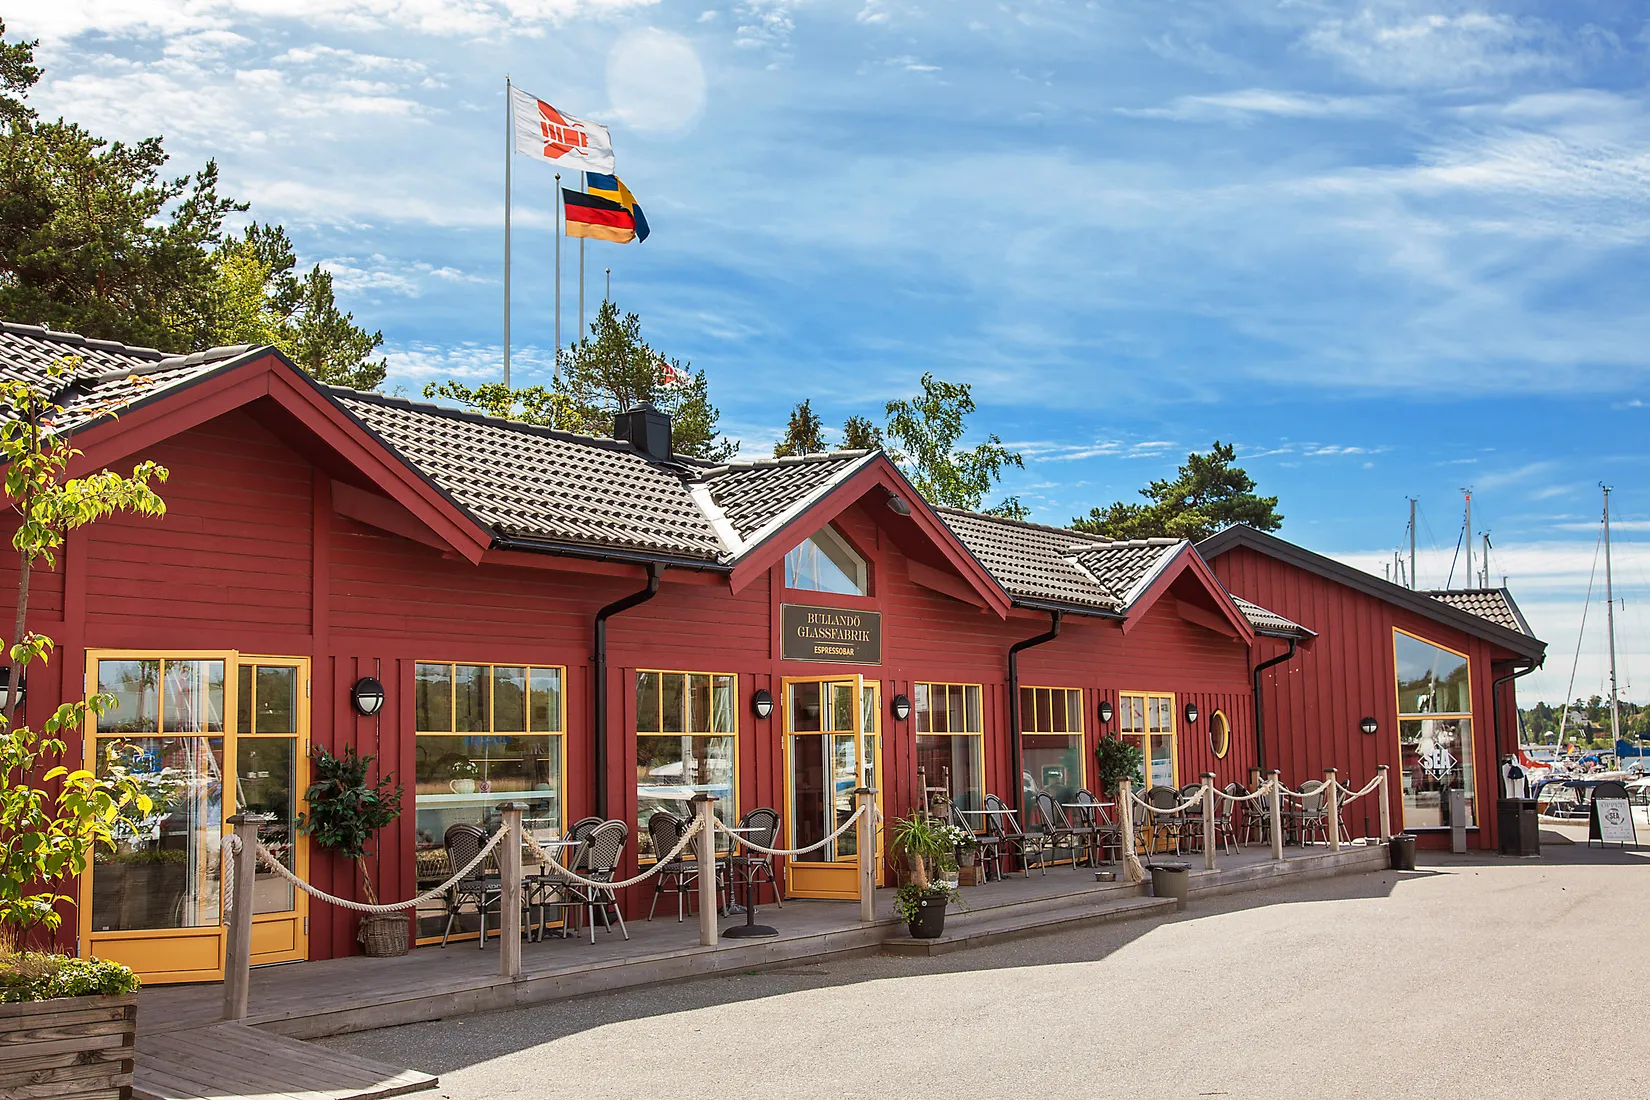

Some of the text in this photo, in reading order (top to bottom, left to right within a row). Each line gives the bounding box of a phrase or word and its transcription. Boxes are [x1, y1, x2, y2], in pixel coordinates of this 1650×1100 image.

[808, 613, 860, 627] BULLANDÖ
[797, 626, 870, 642] GLASSFABRIK
[814, 646, 855, 656] ESPRESSOBAR
[1423, 750, 1450, 769] SEA
